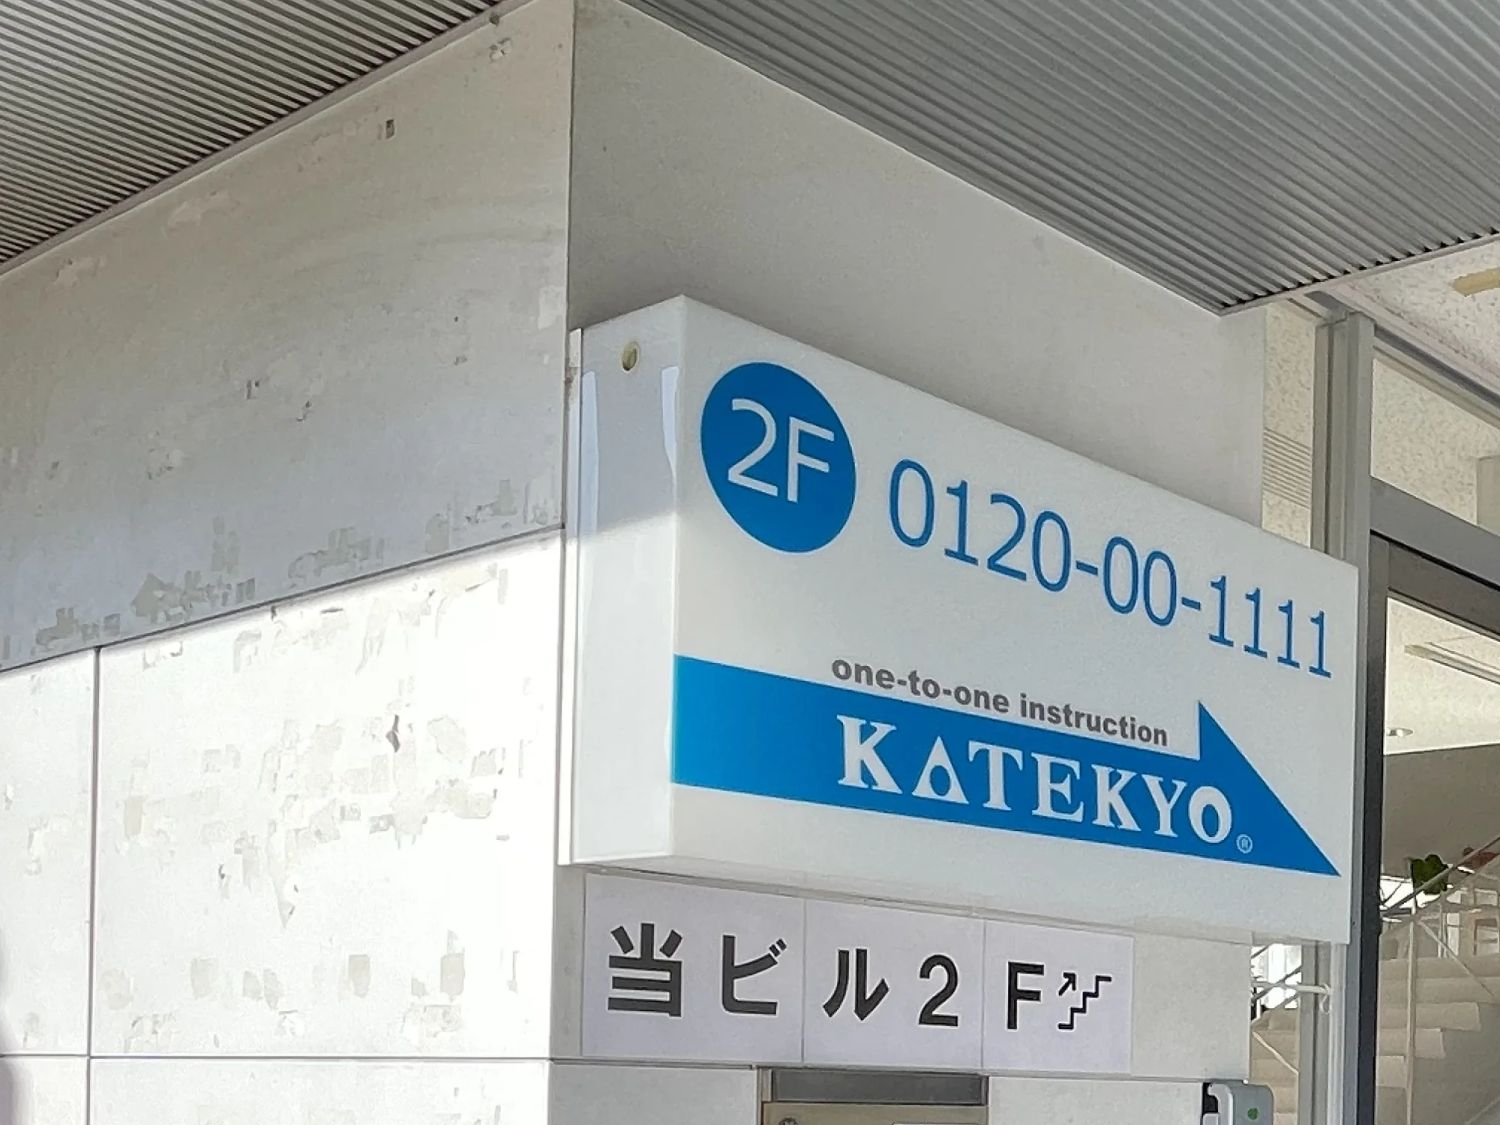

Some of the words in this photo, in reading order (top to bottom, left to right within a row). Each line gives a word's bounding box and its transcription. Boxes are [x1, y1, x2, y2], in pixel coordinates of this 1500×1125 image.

[727, 398, 836, 504] 2F
[889, 458, 1332, 679] 0120-00-1111
[831, 656, 1010, 714] one-to-one
[1019, 692, 1168, 748] instruction
[836, 715, 1233, 845] KATEKYO
